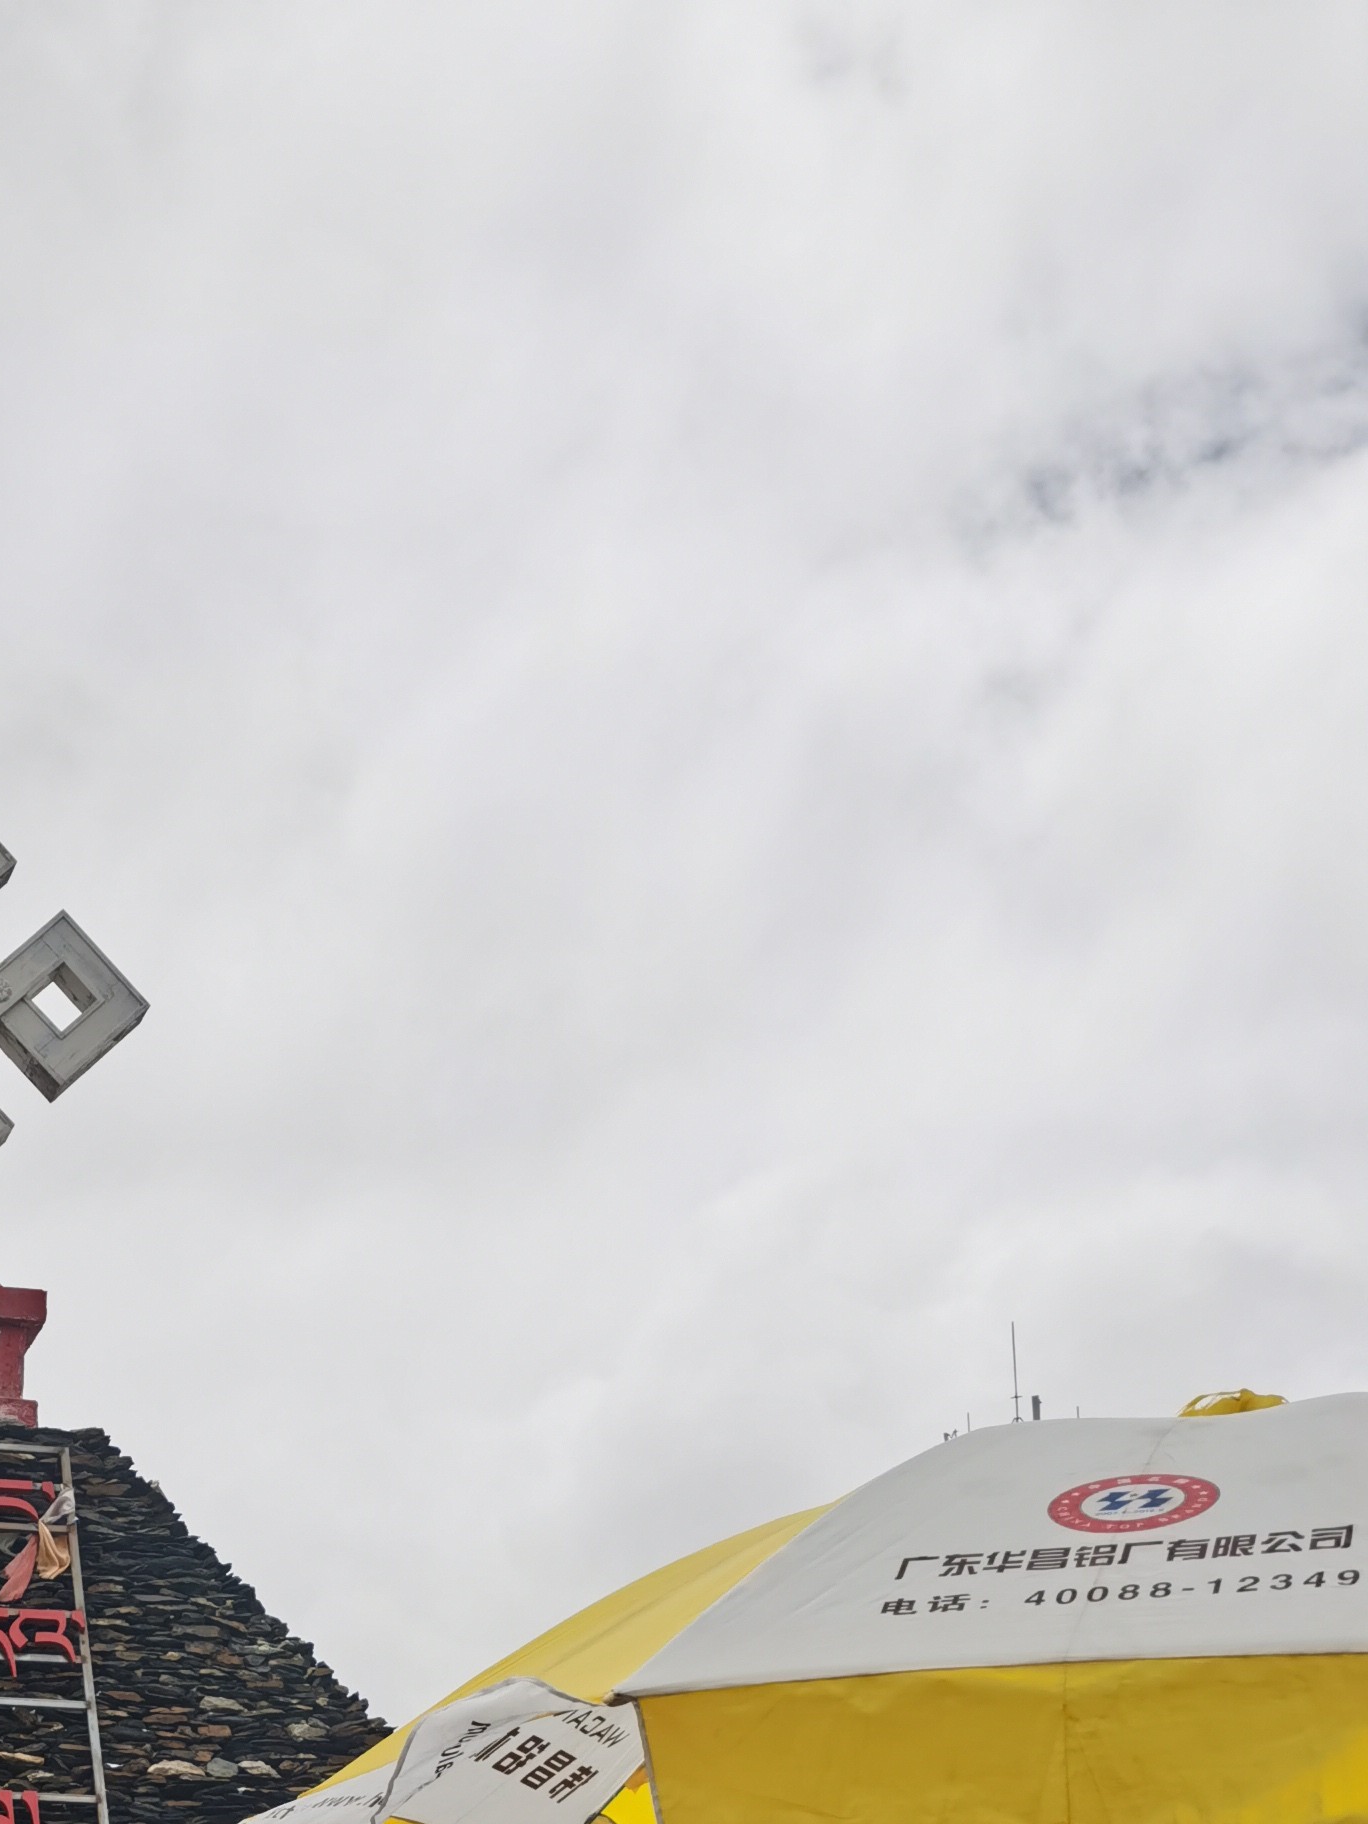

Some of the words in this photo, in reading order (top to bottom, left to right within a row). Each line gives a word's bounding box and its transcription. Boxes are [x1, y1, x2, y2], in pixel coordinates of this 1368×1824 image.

[895, 1524, 1355, 1580] 广东华昌铝厂有限公司
[1025, 1569, 1361, 1606] 40088-12349
